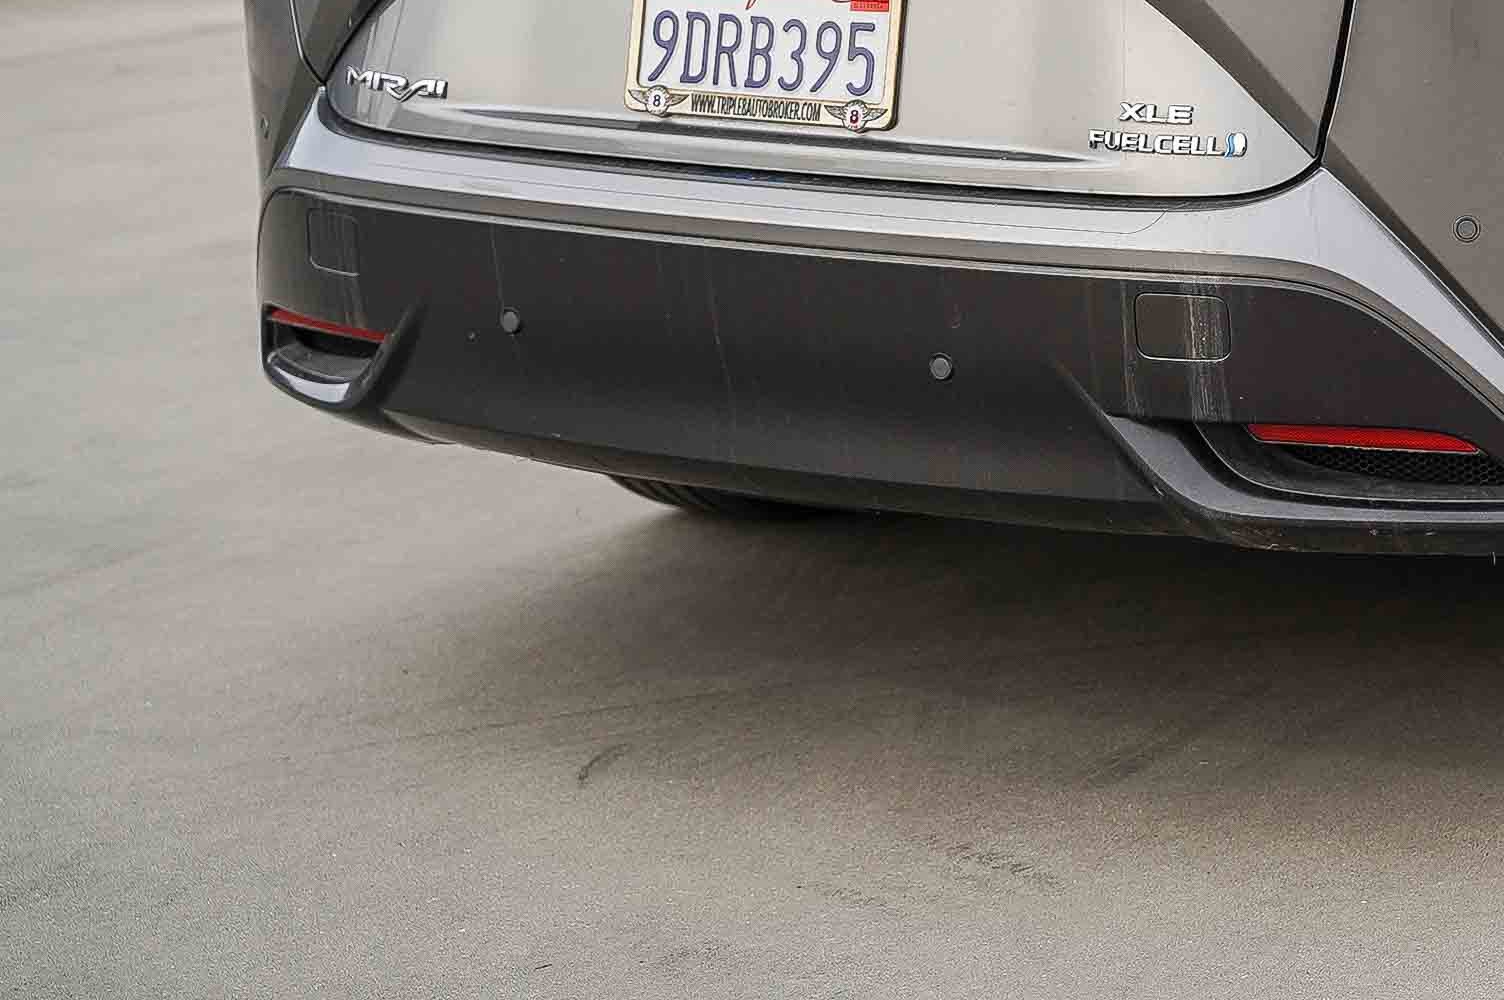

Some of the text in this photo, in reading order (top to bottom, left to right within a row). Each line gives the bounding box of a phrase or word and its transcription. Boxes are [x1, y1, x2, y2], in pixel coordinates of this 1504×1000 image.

[648, 9, 876, 97] 9DRB395
[346, 65, 448, 102] MIRAI
[653, 94, 661, 107] 8
[691, 93, 822, 121] WWW.TRIPLE8AUTOBROKER.COM
[1119, 102, 1194, 125] XLE
[850, 109, 859, 124] 8
[1088, 129, 1227, 157] FUELCELL
